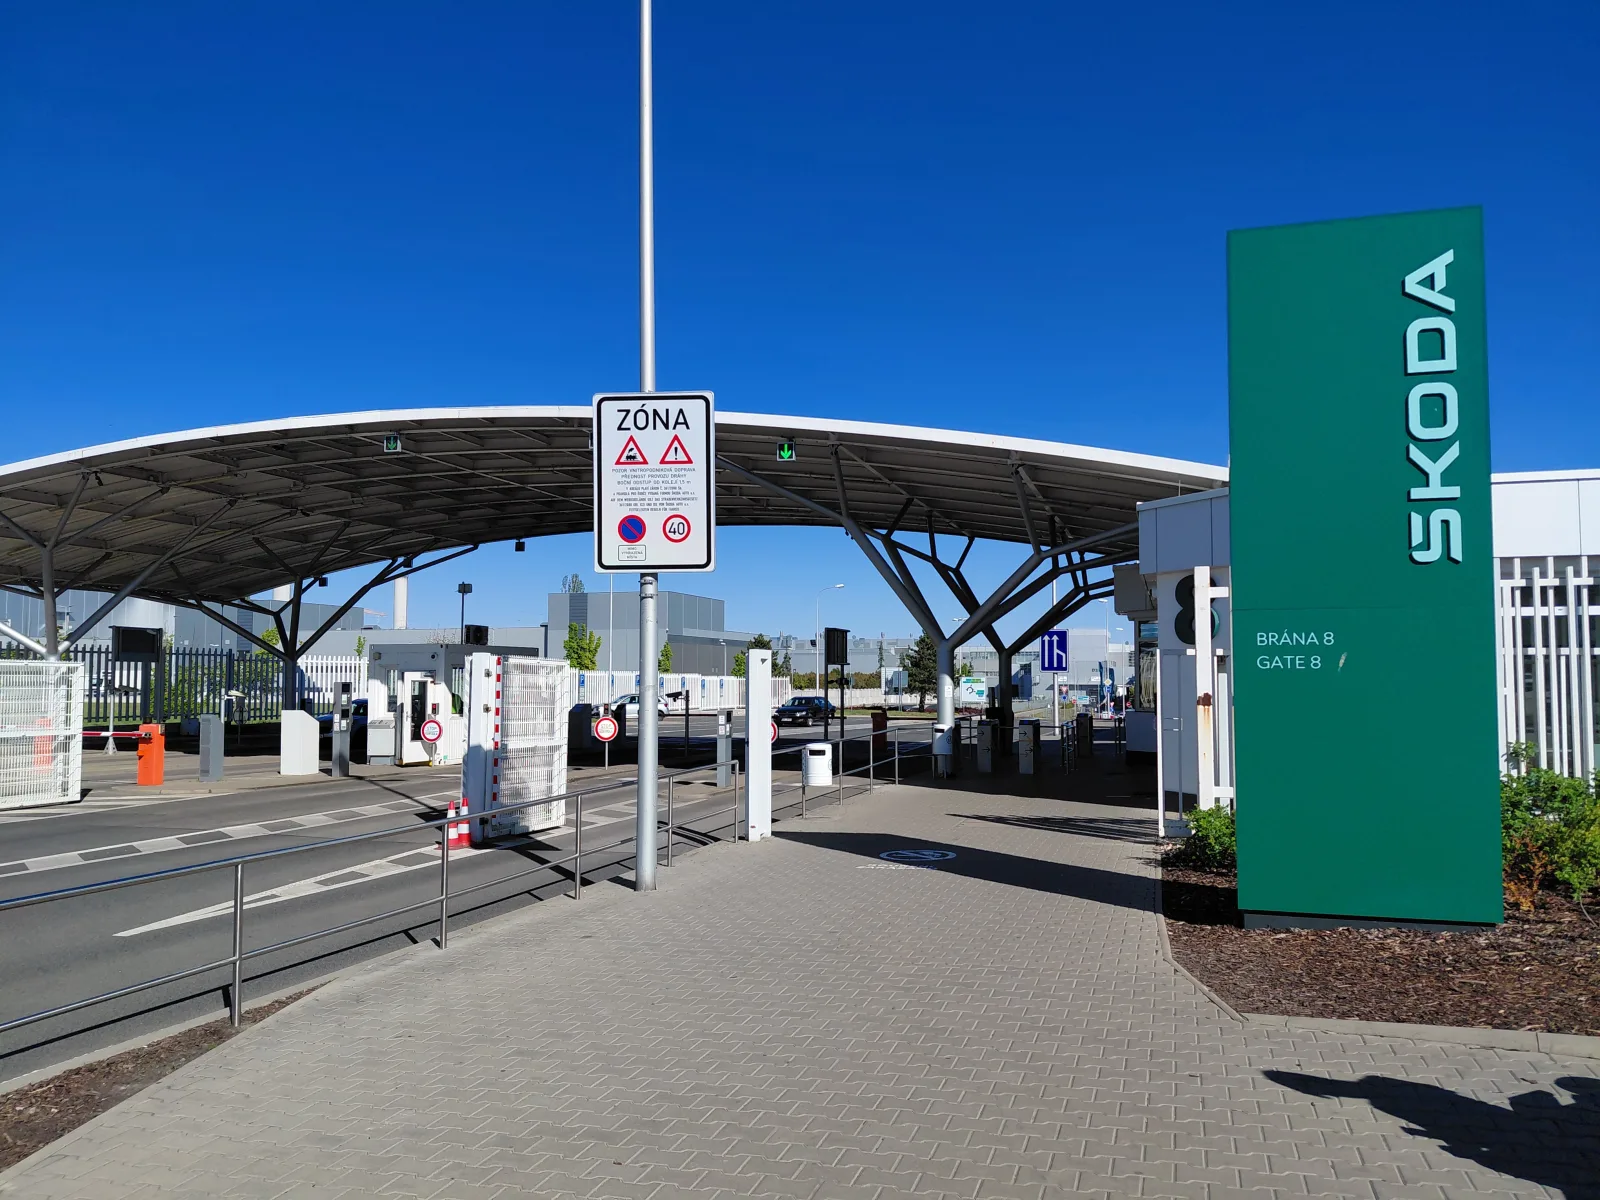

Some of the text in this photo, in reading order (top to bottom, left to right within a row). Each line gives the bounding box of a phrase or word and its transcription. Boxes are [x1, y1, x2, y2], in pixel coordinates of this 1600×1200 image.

[1403, 248, 1464, 564] ŠKODA
[616, 403, 691, 431] ZÓNA
[667, 521, 686, 536] 40
[1256, 629, 1335, 646] BRÁNA 8
[1256, 655, 1322, 669] GATE 8
